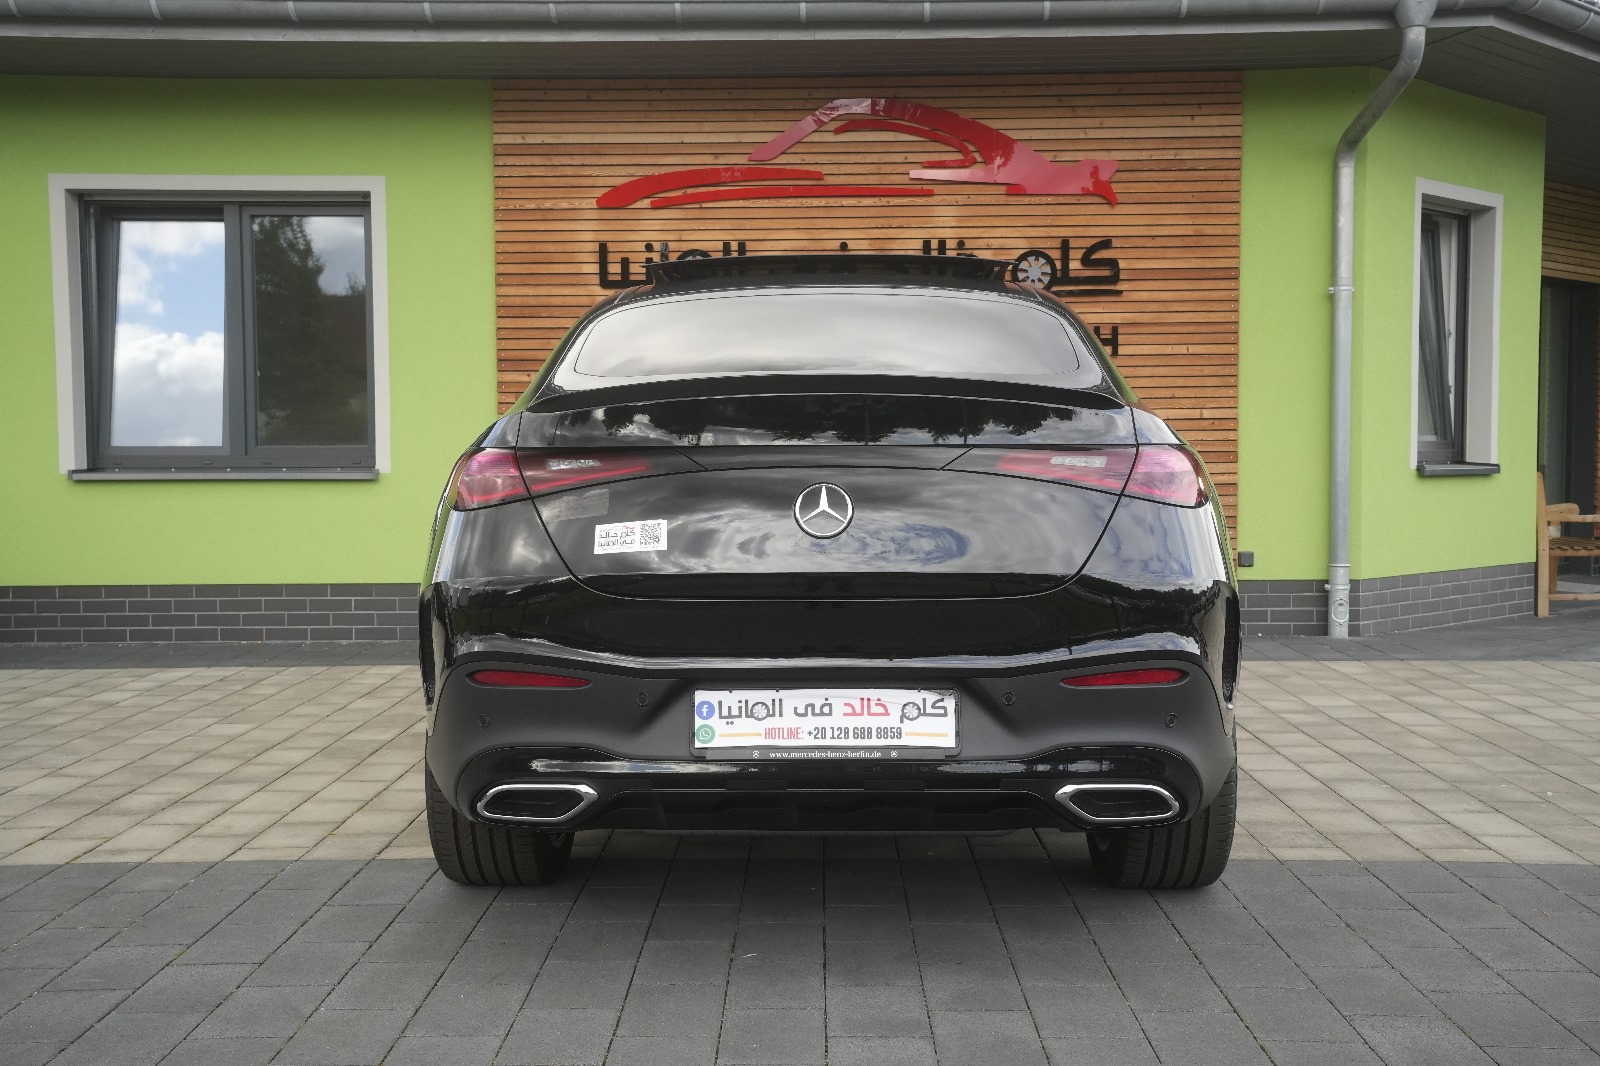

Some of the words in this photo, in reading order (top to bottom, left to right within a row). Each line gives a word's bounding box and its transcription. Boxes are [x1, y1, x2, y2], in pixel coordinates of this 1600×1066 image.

[717, 698, 784, 726] المانيا
[842, 697, 891, 717] خالد
[899, 697, 949, 725] كلم
[764, 727, 804, 740] HOTLINE:
[806, 726, 827, 740] +20
[829, 726, 850, 740] 128
[852, 726, 873, 740] 688
[875, 726, 903, 740] 8859
[769, 750, 882, 759] www.mercedes-benz-berlin.de
